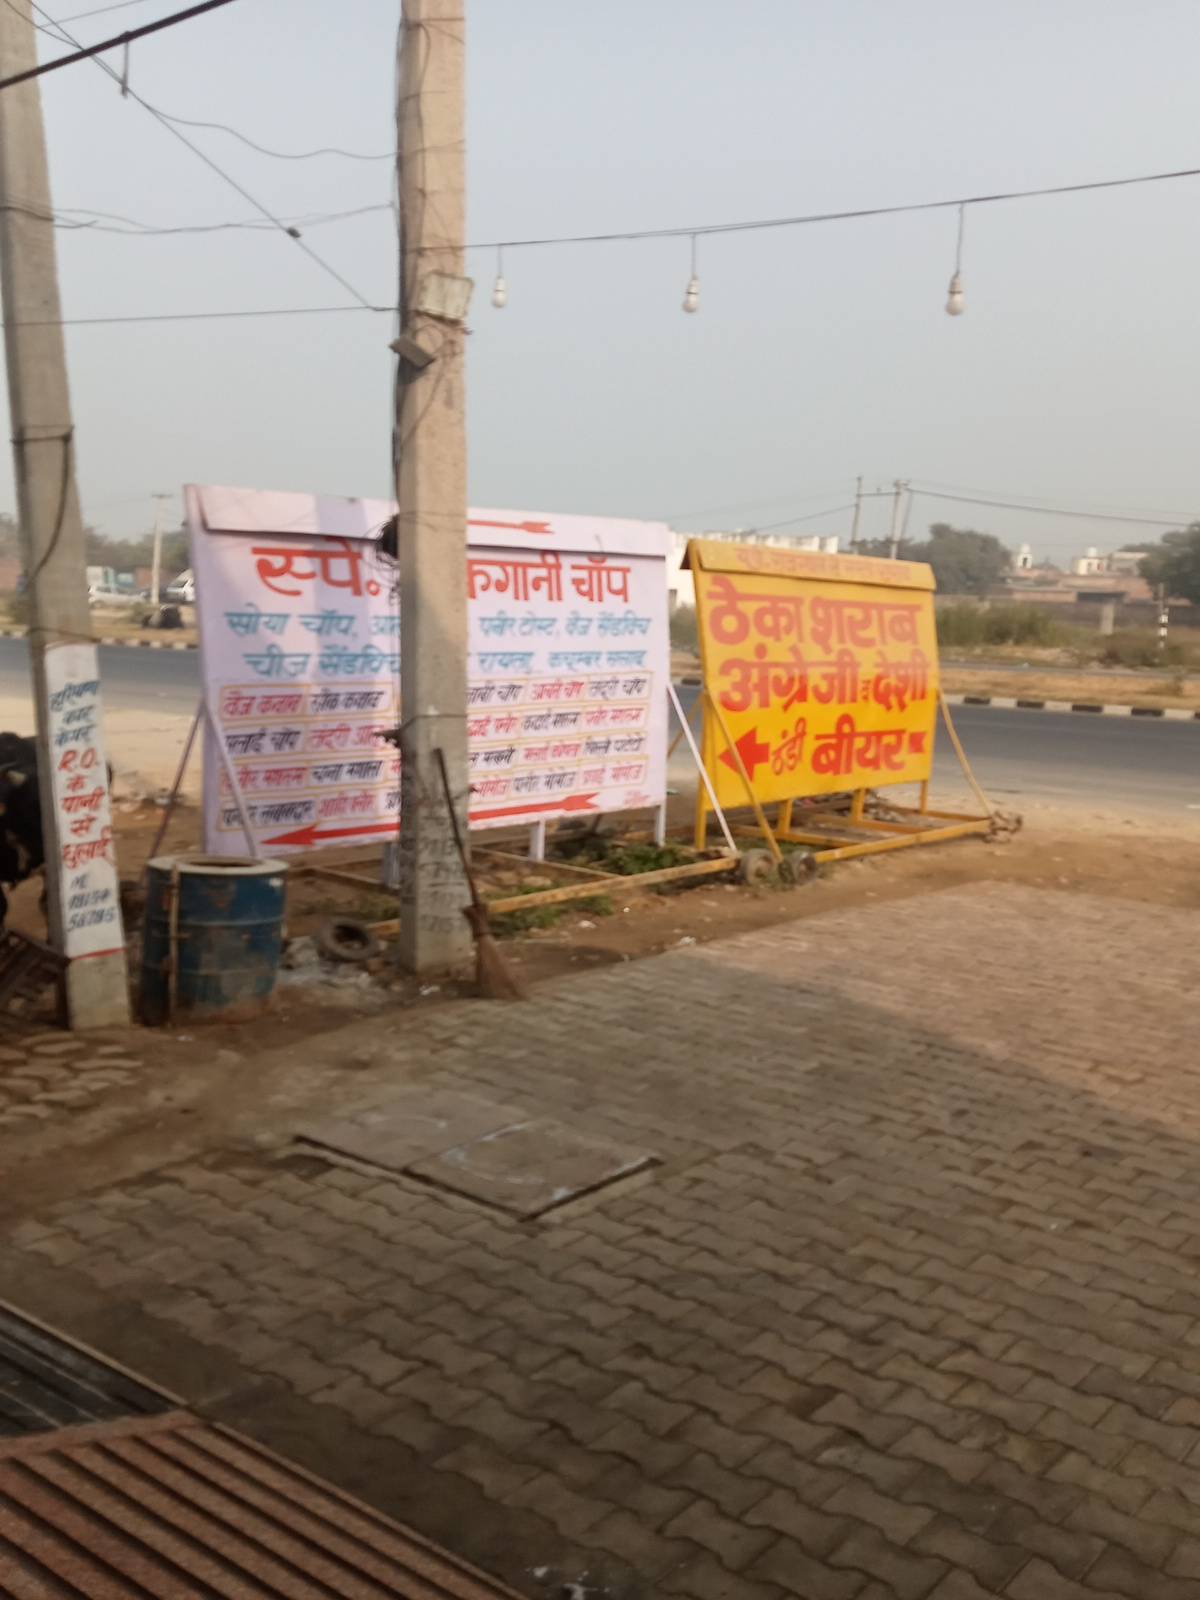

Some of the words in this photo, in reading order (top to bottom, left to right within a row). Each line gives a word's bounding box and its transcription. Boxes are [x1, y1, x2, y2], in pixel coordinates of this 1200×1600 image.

[706, 575, 804, 645] ठेका
[810, 595, 922, 654] शराब
[811, 713, 908, 777] बीयर
